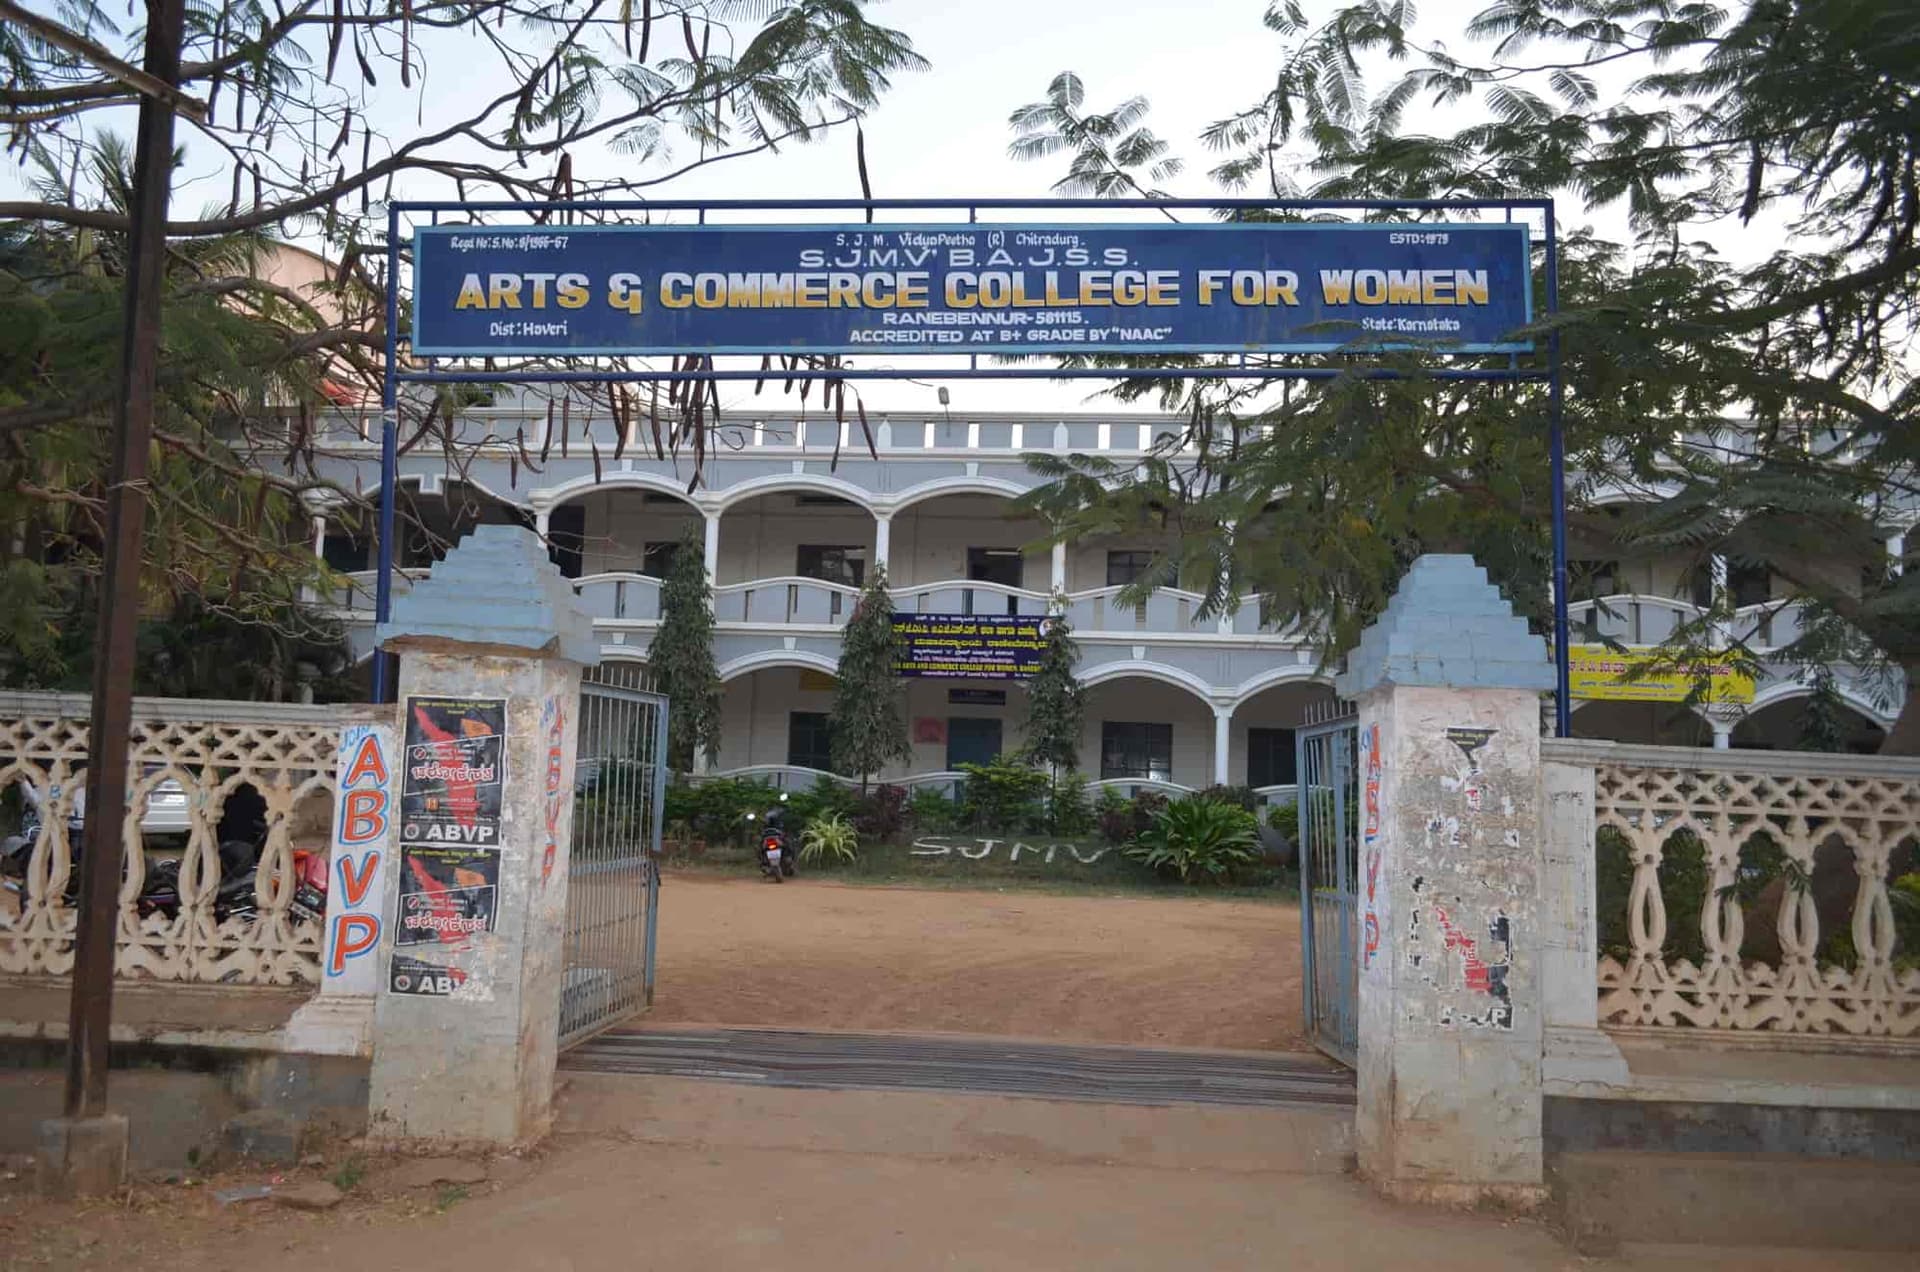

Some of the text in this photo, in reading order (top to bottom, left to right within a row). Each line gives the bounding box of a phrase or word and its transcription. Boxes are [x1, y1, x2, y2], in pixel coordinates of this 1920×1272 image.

[988, 231, 1005, 249] (R)
[455, 268, 1490, 314] ARTS & COMMERCE COLLEGE FOR WOMEN
[850, 329, 964, 343] ACCREDITED
[970, 329, 995, 342] AT
[1000, 329, 1022, 342] B+
[1027, 329, 1086, 342] GRADE
[1089, 328, 1112, 341] BY
[426, 824, 493, 842] ABVP
[327, 733, 389, 978] ABVP
[910, 836, 1113, 863] SJMV
